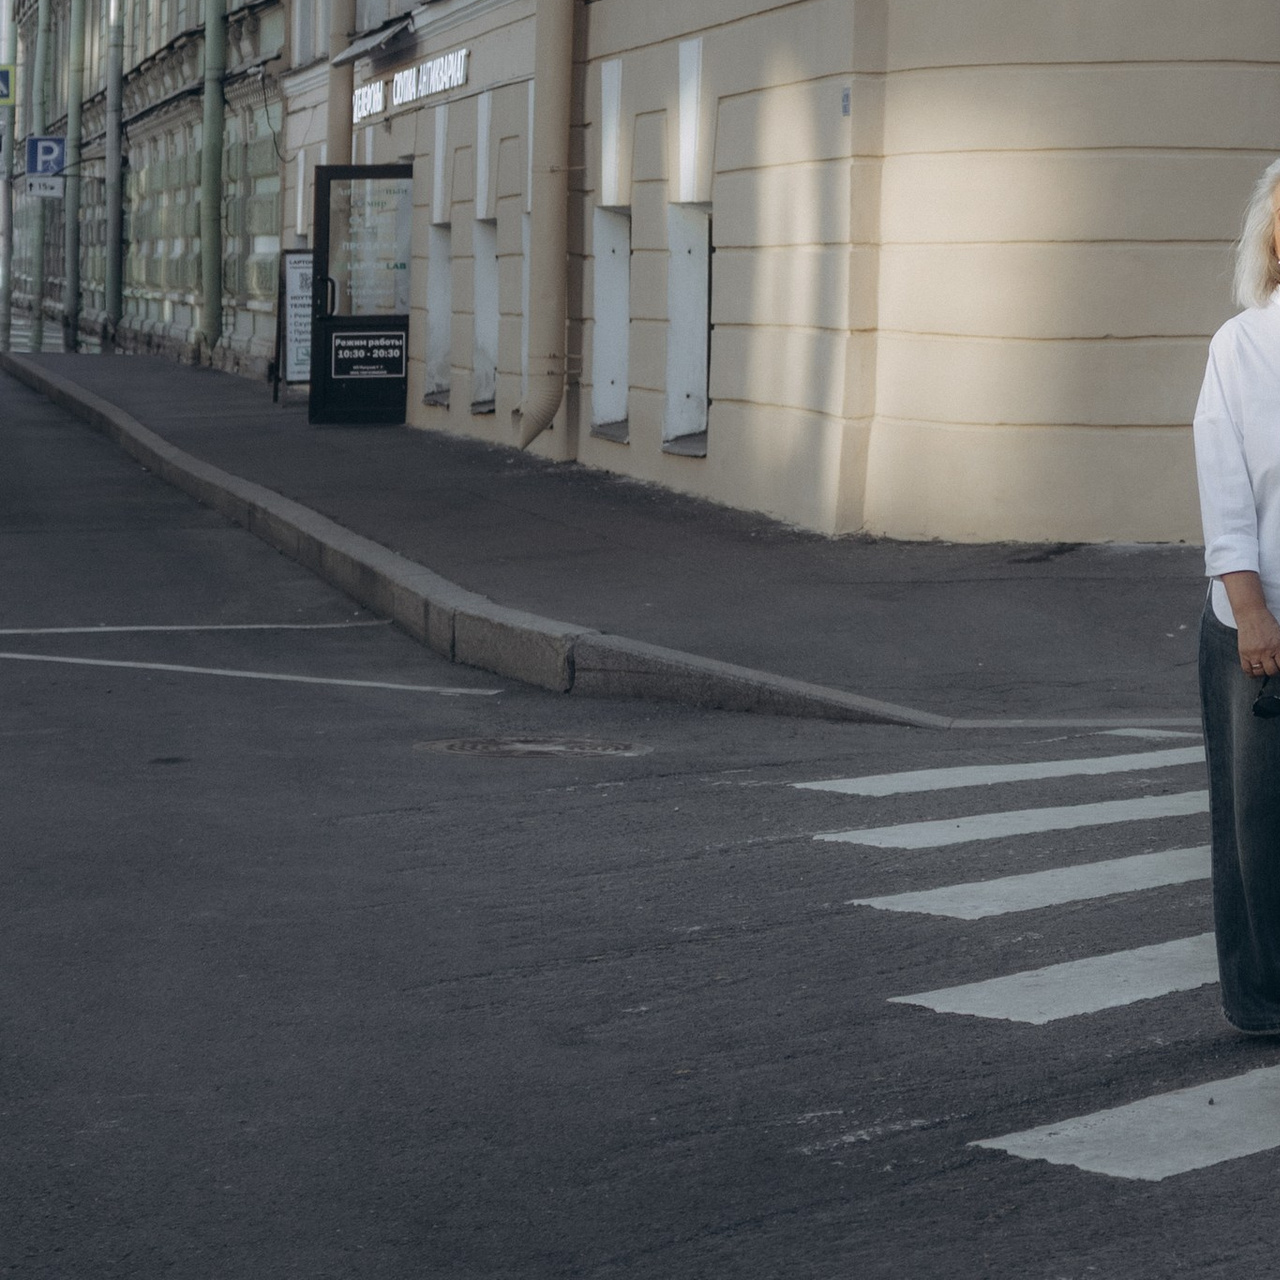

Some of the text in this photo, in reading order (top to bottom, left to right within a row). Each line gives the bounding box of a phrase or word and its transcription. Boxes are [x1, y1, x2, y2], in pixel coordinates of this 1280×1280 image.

[37, 140, 59, 172] P
[335, 337, 403, 348] Режим работы
[337, 349, 365, 358] 10:30
[372, 349, 400, 358] 20:30
